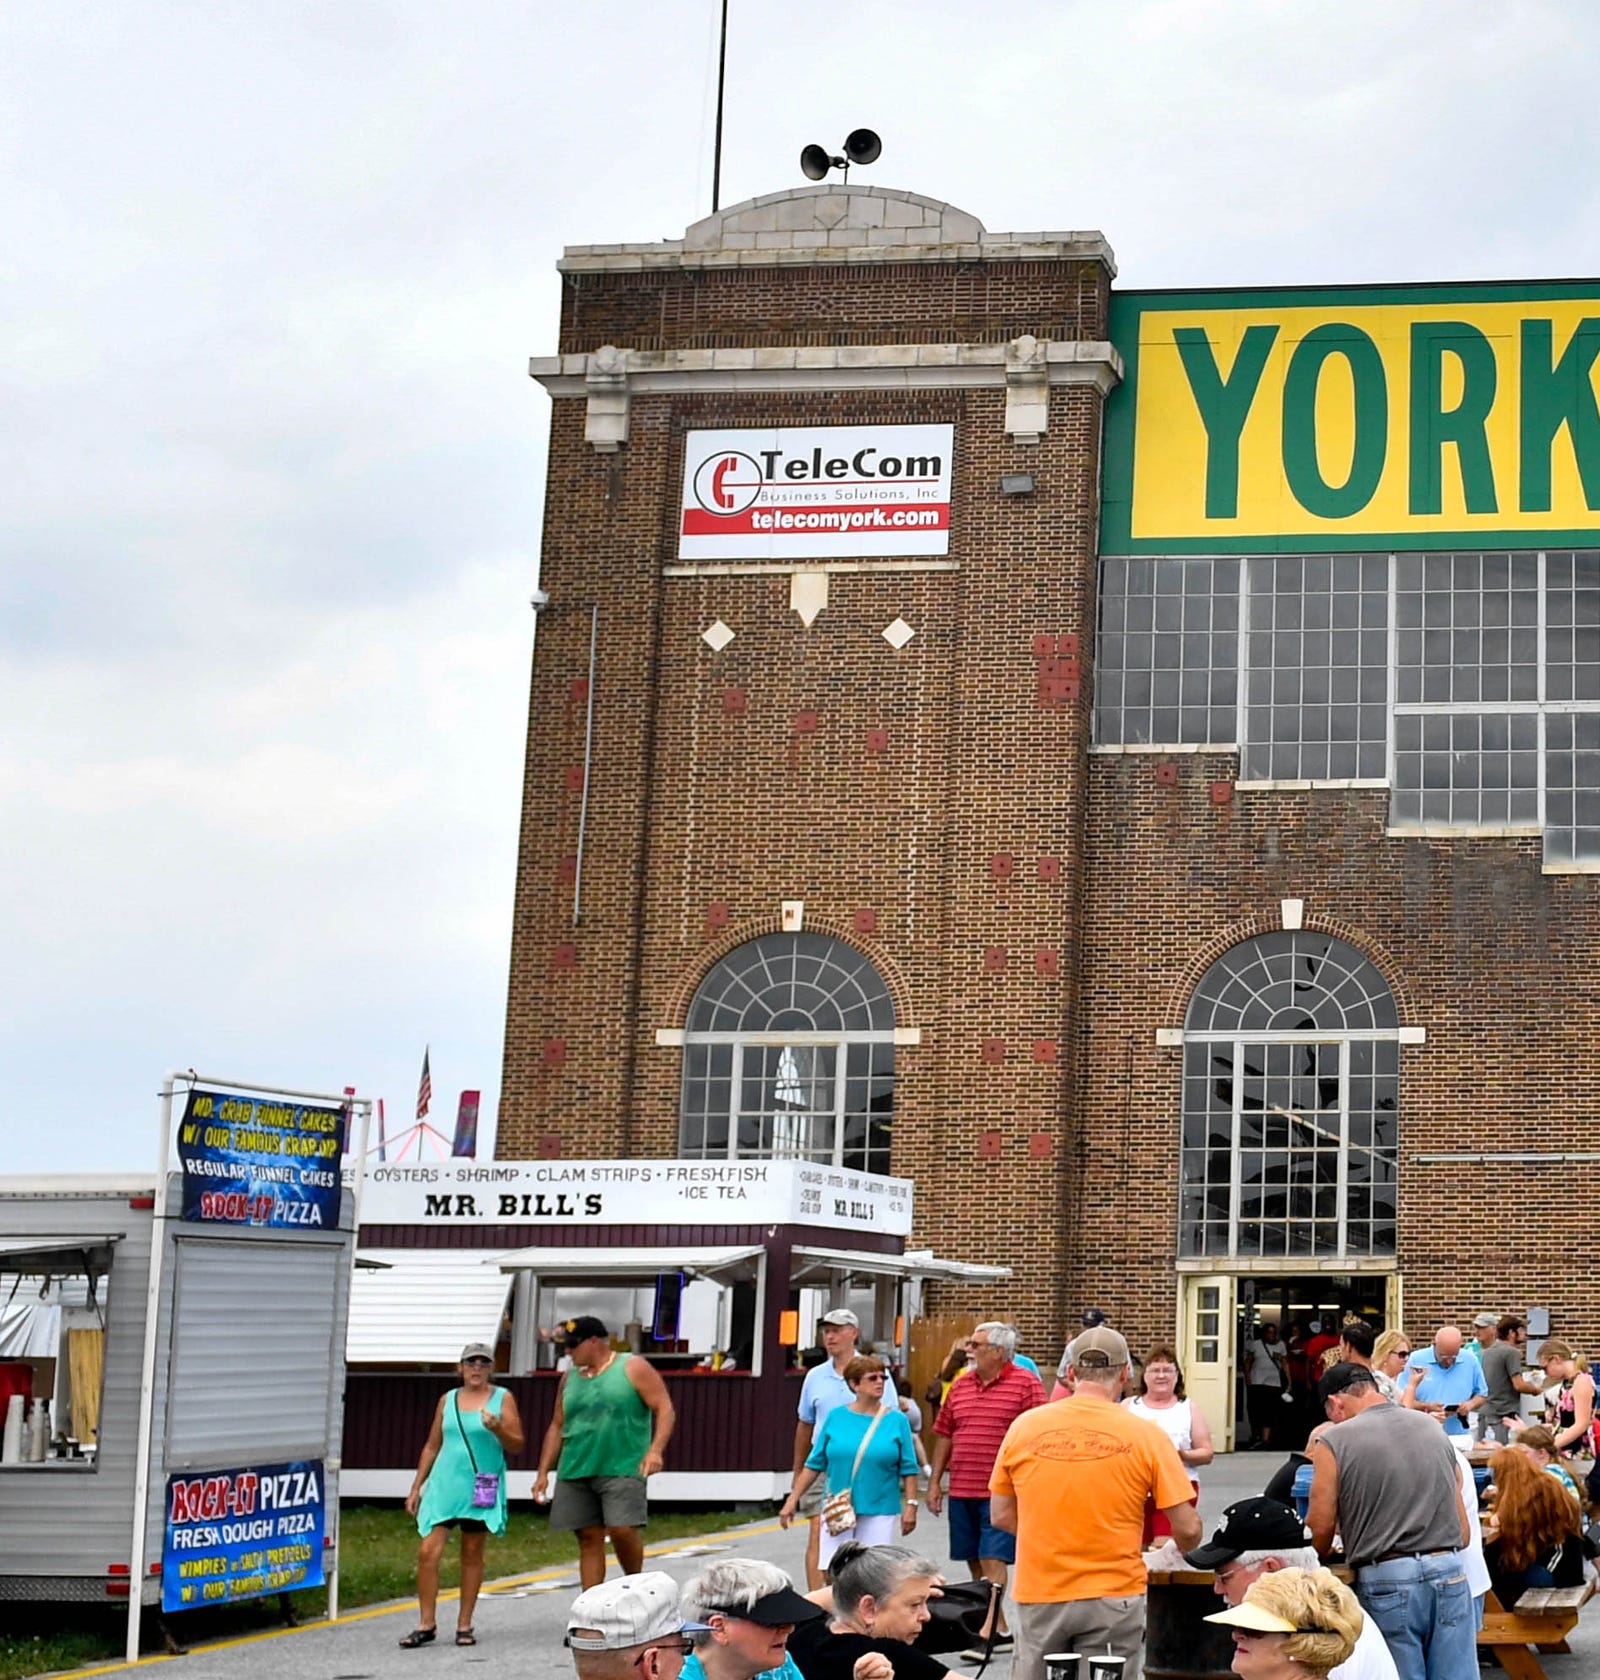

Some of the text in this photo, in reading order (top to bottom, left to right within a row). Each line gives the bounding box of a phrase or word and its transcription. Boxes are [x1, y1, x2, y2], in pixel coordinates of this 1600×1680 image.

[760, 447, 942, 481] TeleCom
[760, 487, 939, 502] Business Solutions, Inc
[751, 508, 939, 532] telecomyork.com
[219, 1100, 252, 1124] CRAB
[255, 1105, 296, 1129] FUNNEL
[300, 1110, 337, 1132] CAKES
[183, 1124, 200, 1146] W/
[204, 1126, 231, 1148] OUR
[234, 1131, 281, 1153] FAMOUS
[185, 1158, 246, 1179] REGULAR
[251, 1165, 296, 1185] FUNNEL
[300, 1170, 335, 1188] CAKES
[373, 1167, 439, 1183] OYSTERS
[455, 1167, 519, 1183] SHRIMP
[536, 1167, 586, 1183] CLAM
[591, 1167, 652, 1182] STRIPS
[424, 1192, 603, 1217] MR. BILL'S
[685, 1186, 747, 1199] ICE TEA
[200, 1190, 322, 1225] ROCK-IT PIZZA
[171, 1471, 320, 1524] ROCK-IT PIZZA
[173, 1513, 315, 1551] FRESH DOUGH PIZZA
[179, 1556, 228, 1579] WIMPIES
[267, 1543, 312, 1565] PRETZELS
[203, 1581, 226, 1600] OUR
